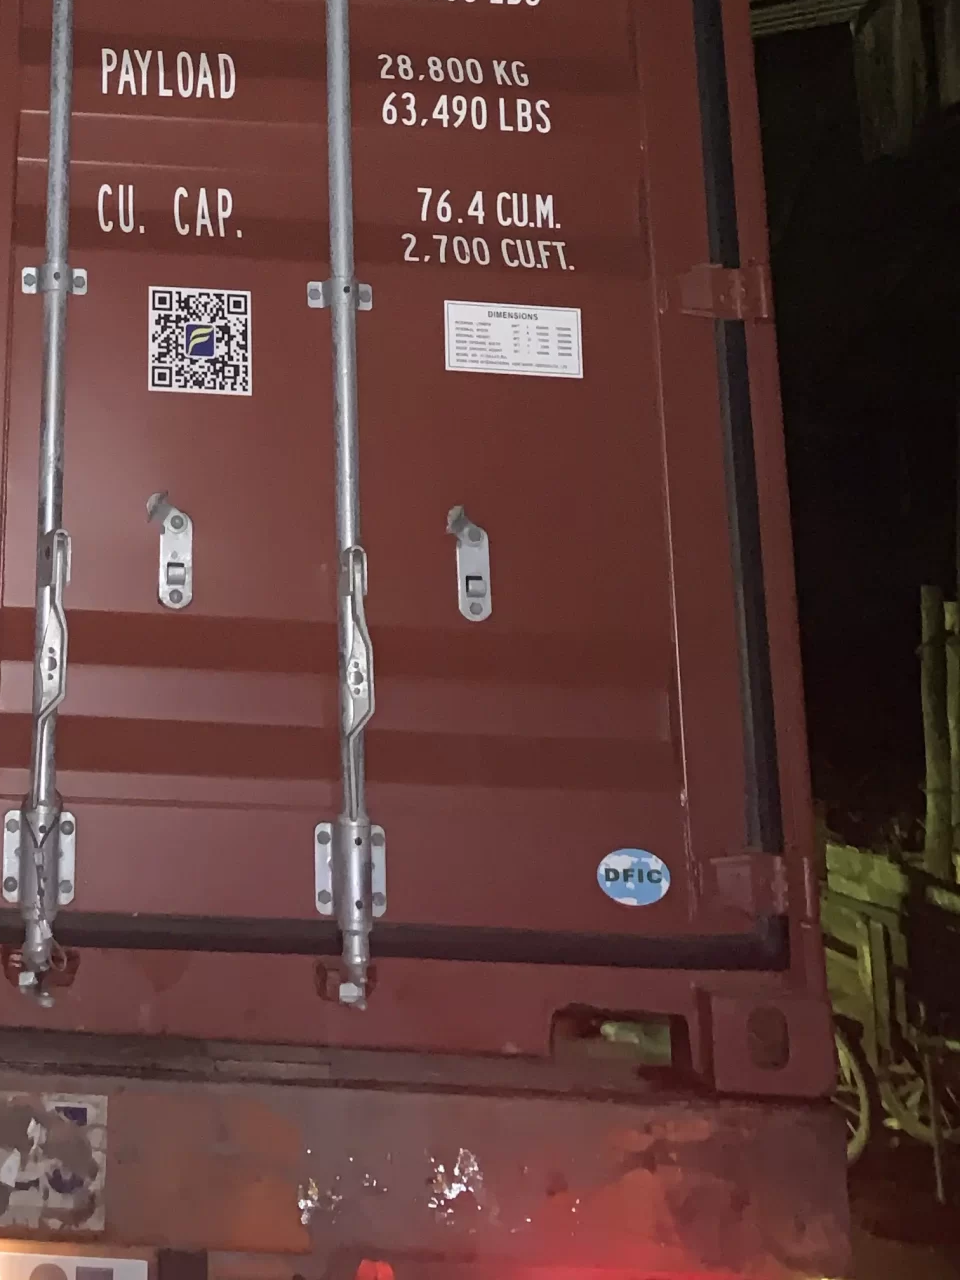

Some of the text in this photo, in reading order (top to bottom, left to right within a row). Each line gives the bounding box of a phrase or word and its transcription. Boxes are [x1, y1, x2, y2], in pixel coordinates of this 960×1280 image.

[101, 48, 236, 99] PAYLOAD
[377, 54, 530, 87] 28,800 KG
[382, 91, 552, 134] 63,490 LBS
[97, 184, 243, 238] CU. CAP.
[417, 187, 561, 229] 76.4 CU.M.
[401, 233, 575, 271] 2,700 CU.FT.
[487, 310, 539, 321] DIMENSIONS
[604, 867, 663, 884] DFIC
